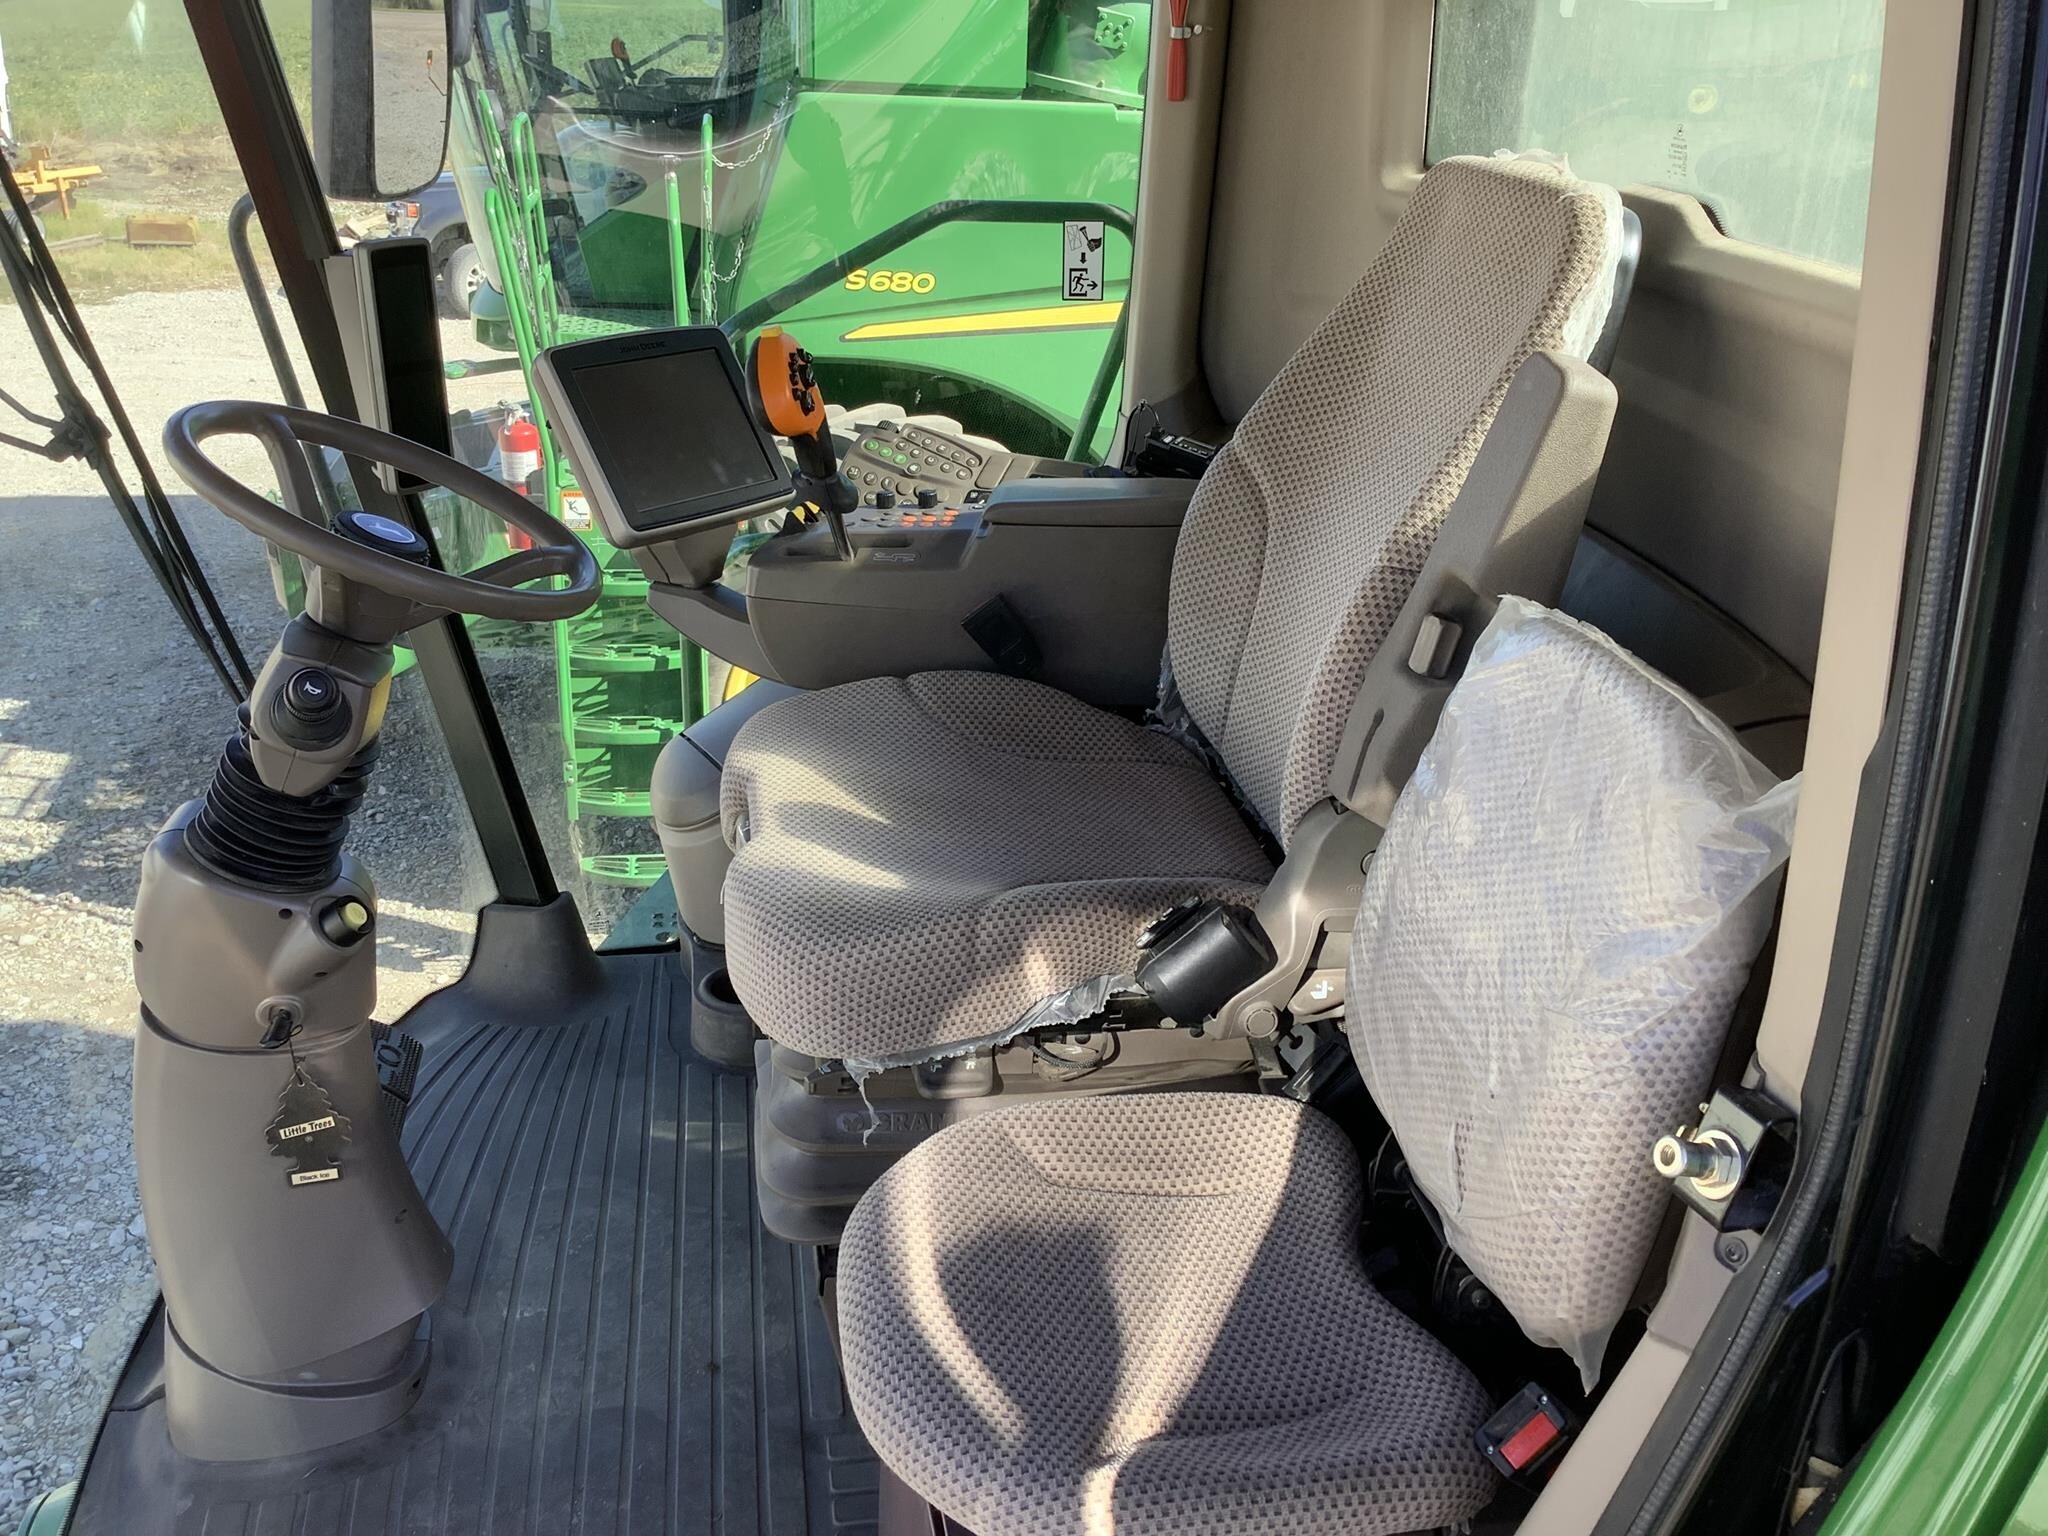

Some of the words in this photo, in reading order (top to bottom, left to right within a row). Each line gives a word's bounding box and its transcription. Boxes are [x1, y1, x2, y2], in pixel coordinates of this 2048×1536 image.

[844, 267, 937, 295] S680
[283, 1125, 307, 1138] Little
[308, 1119, 333, 1131] Trees
[300, 1174, 319, 1182] Black
